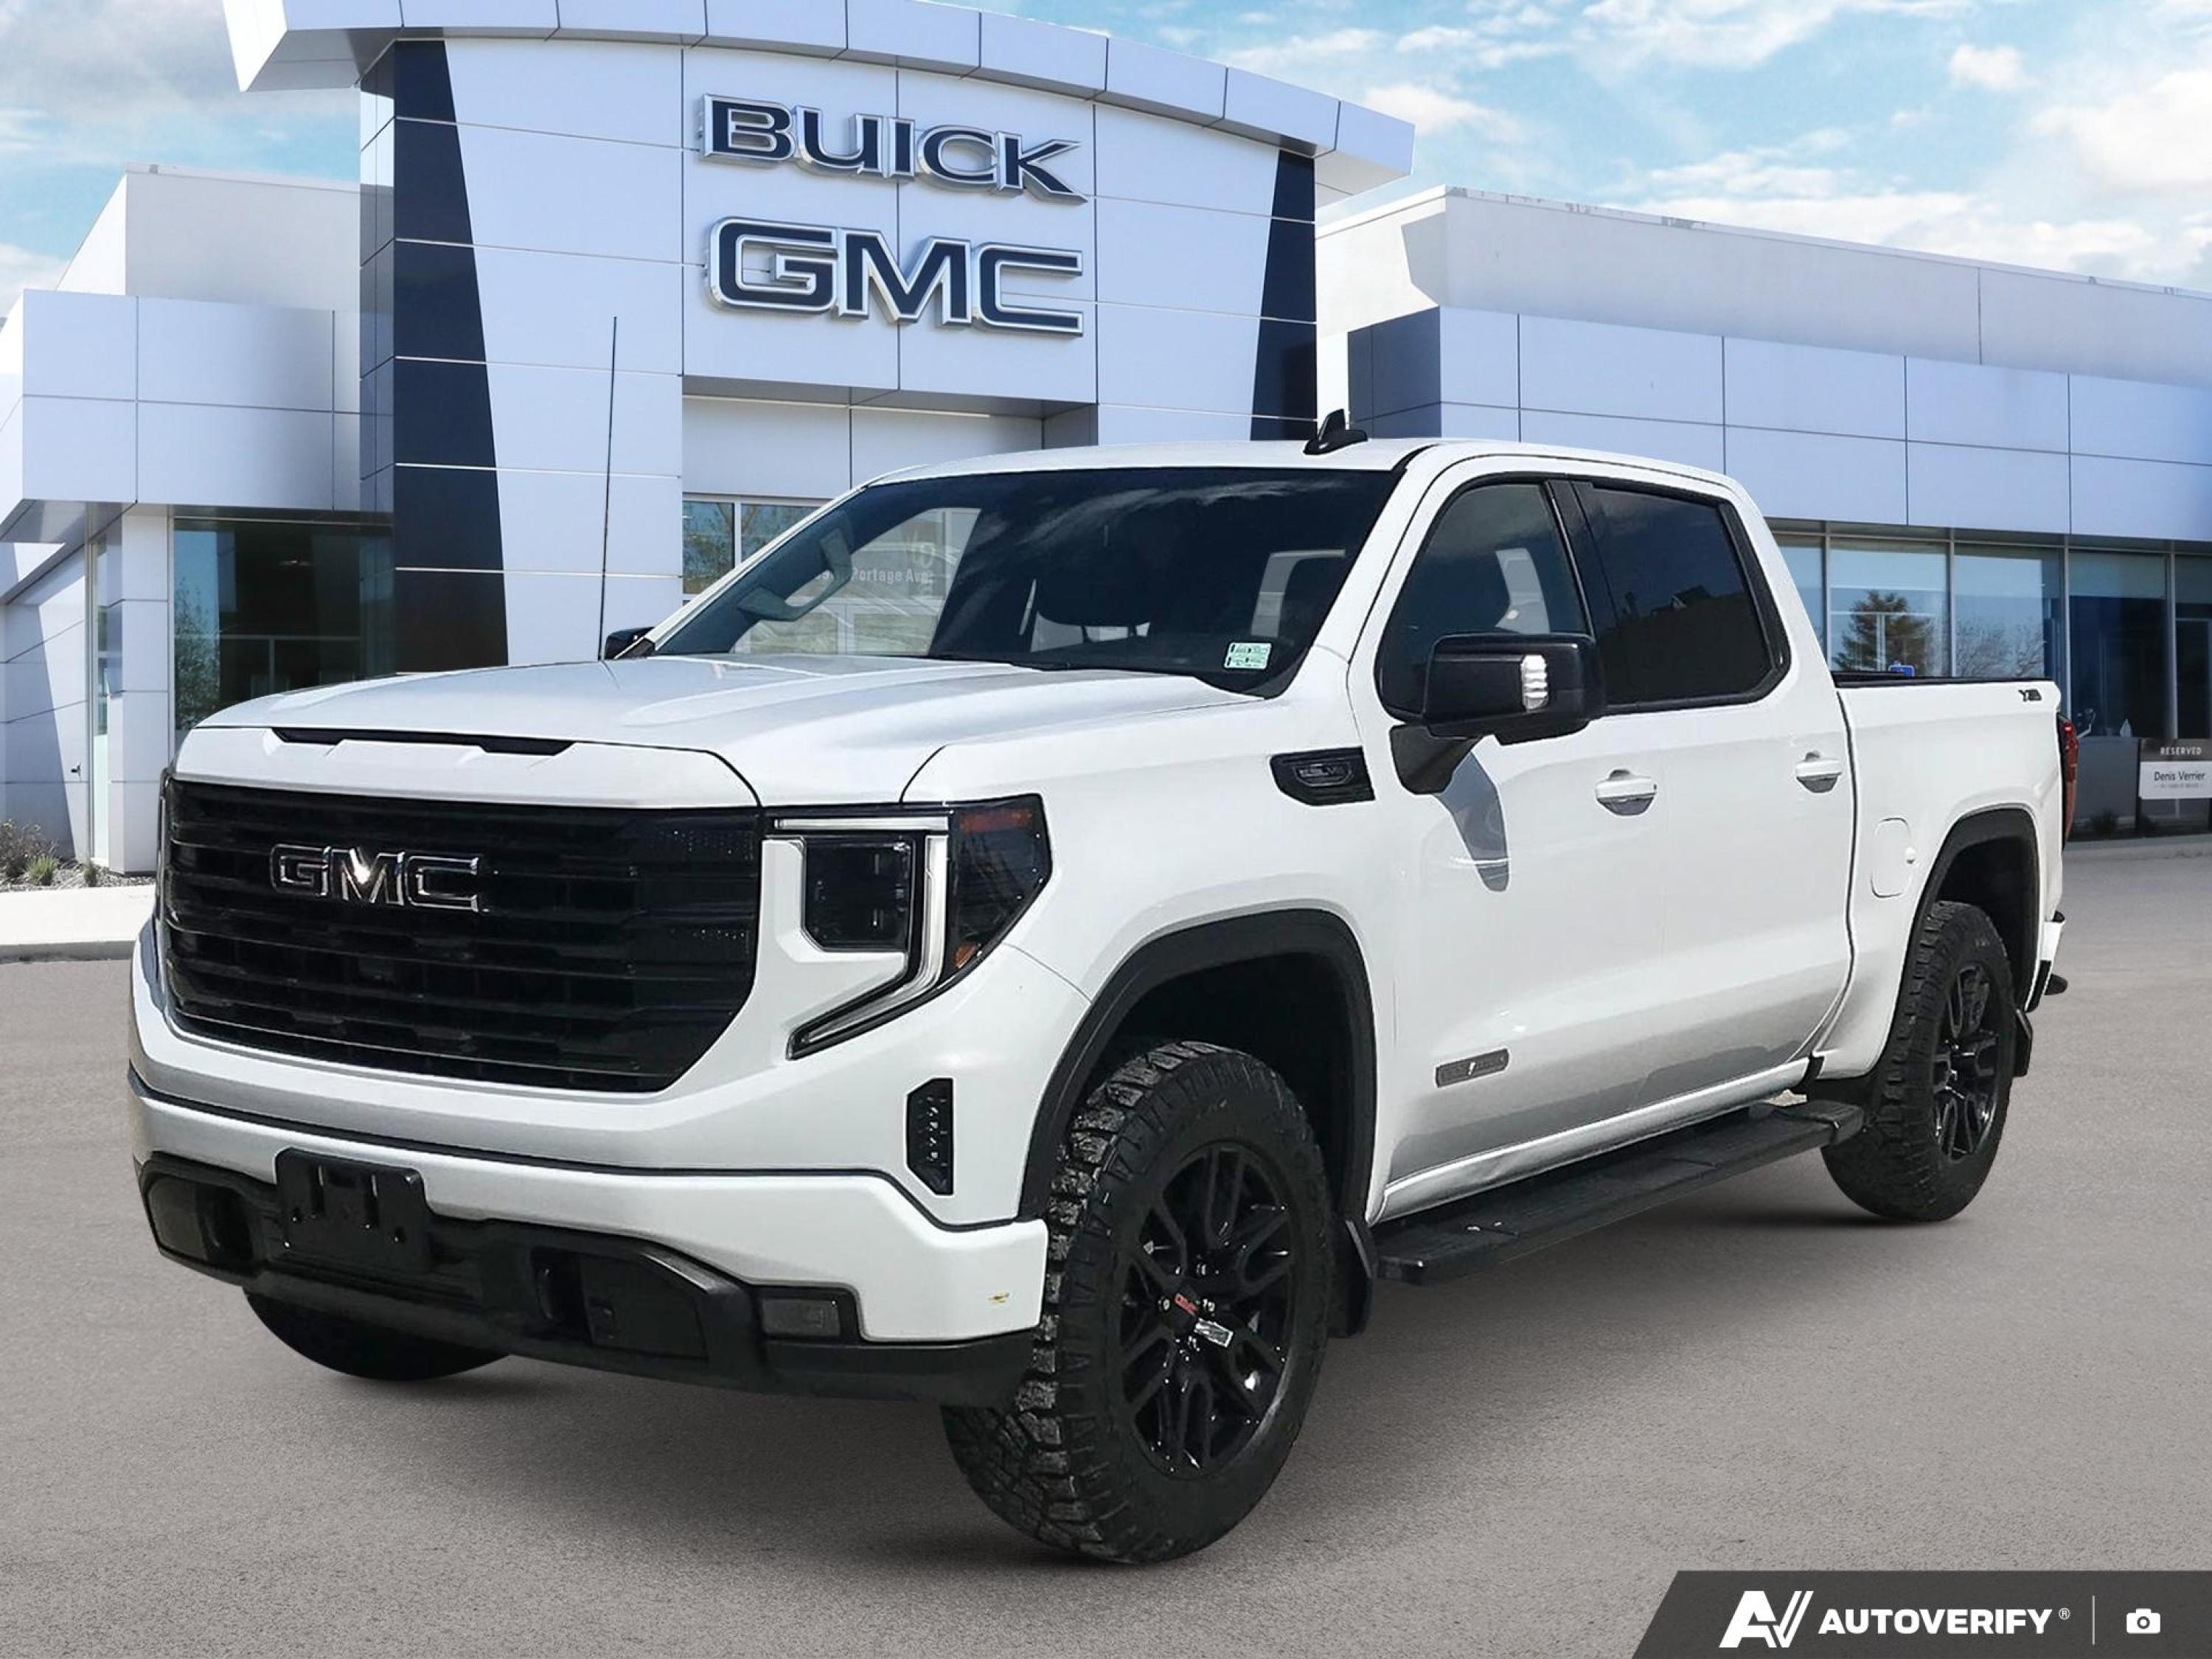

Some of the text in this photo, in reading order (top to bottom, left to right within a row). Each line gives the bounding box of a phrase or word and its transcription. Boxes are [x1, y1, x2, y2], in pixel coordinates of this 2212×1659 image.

[700, 94, 1088, 205] BUICK
[708, 216, 1084, 337] GMC
[2154, 771, 2205, 781] Denis Verrier
[2160, 747, 2202, 755] RESERVED
[269, 843, 480, 912] GMC
